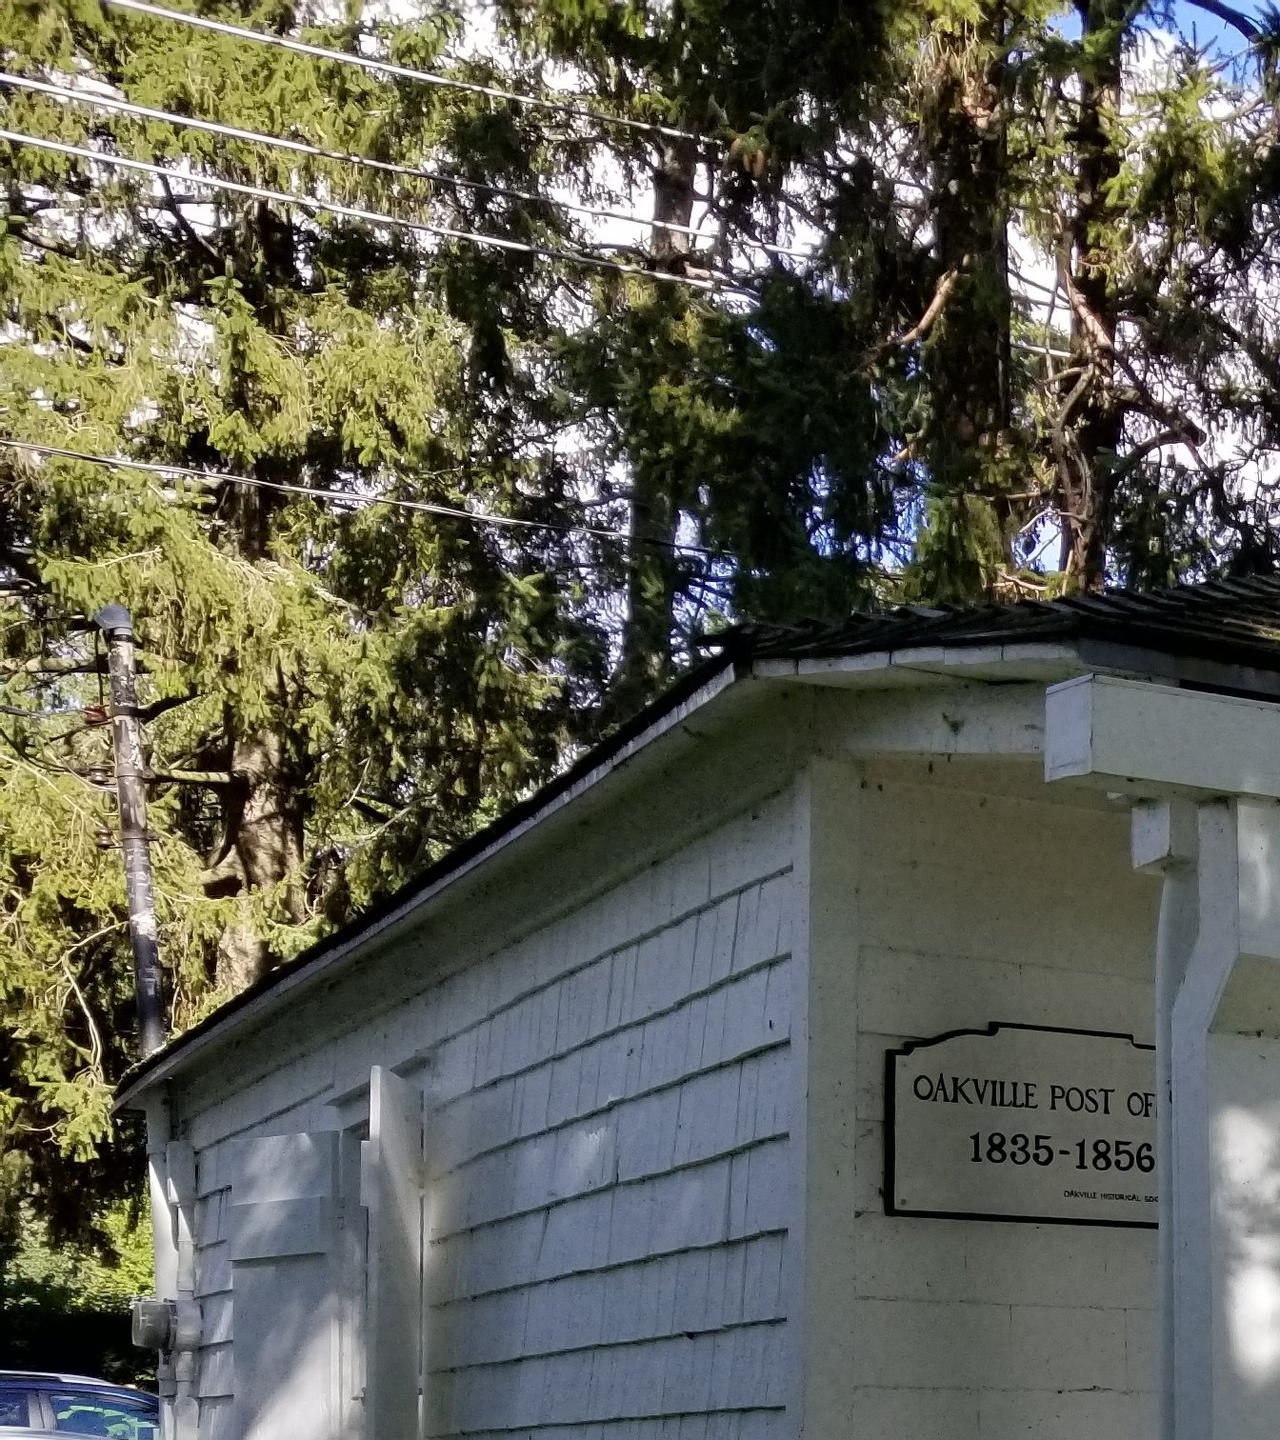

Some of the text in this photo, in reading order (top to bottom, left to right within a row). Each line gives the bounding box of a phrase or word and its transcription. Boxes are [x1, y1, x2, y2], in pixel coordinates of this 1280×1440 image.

[913, 1073, 1158, 1119] OAKVILLE POST OF
[969, 1132, 1155, 1173] 1835-1856
[1063, 1190, 1097, 1200] OAKVILLE
[1100, 1193, 1142, 1202] HISTORICAL
